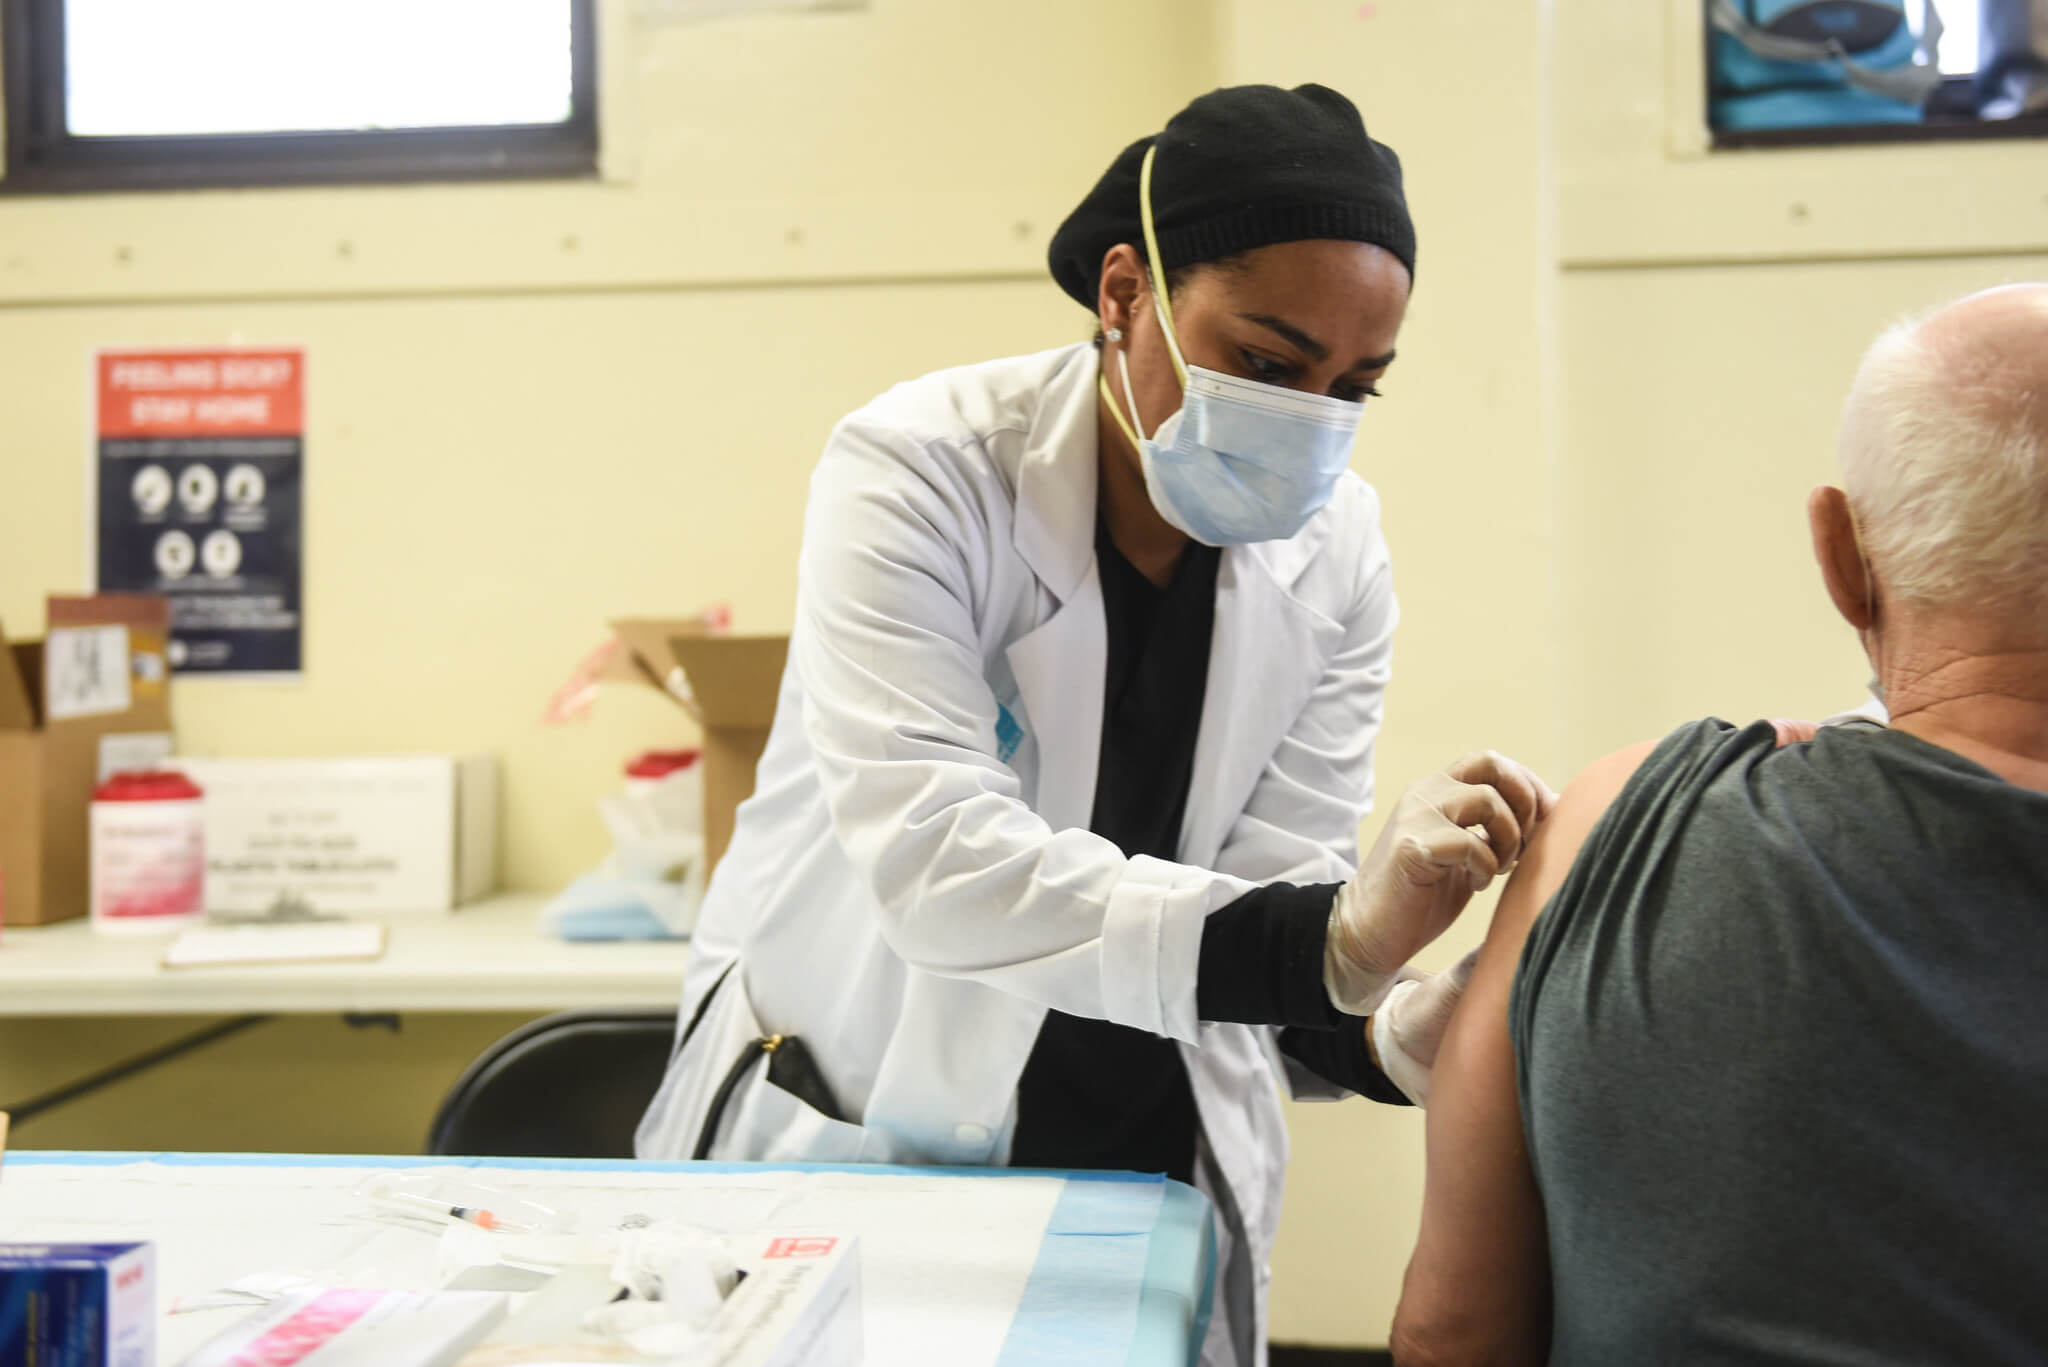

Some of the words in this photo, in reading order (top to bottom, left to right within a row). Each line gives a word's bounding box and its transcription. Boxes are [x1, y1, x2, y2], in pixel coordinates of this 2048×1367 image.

[110, 360, 215, 390] FEELING
[131, 396, 191, 426] STAY
[195, 394, 271, 425] HOME
